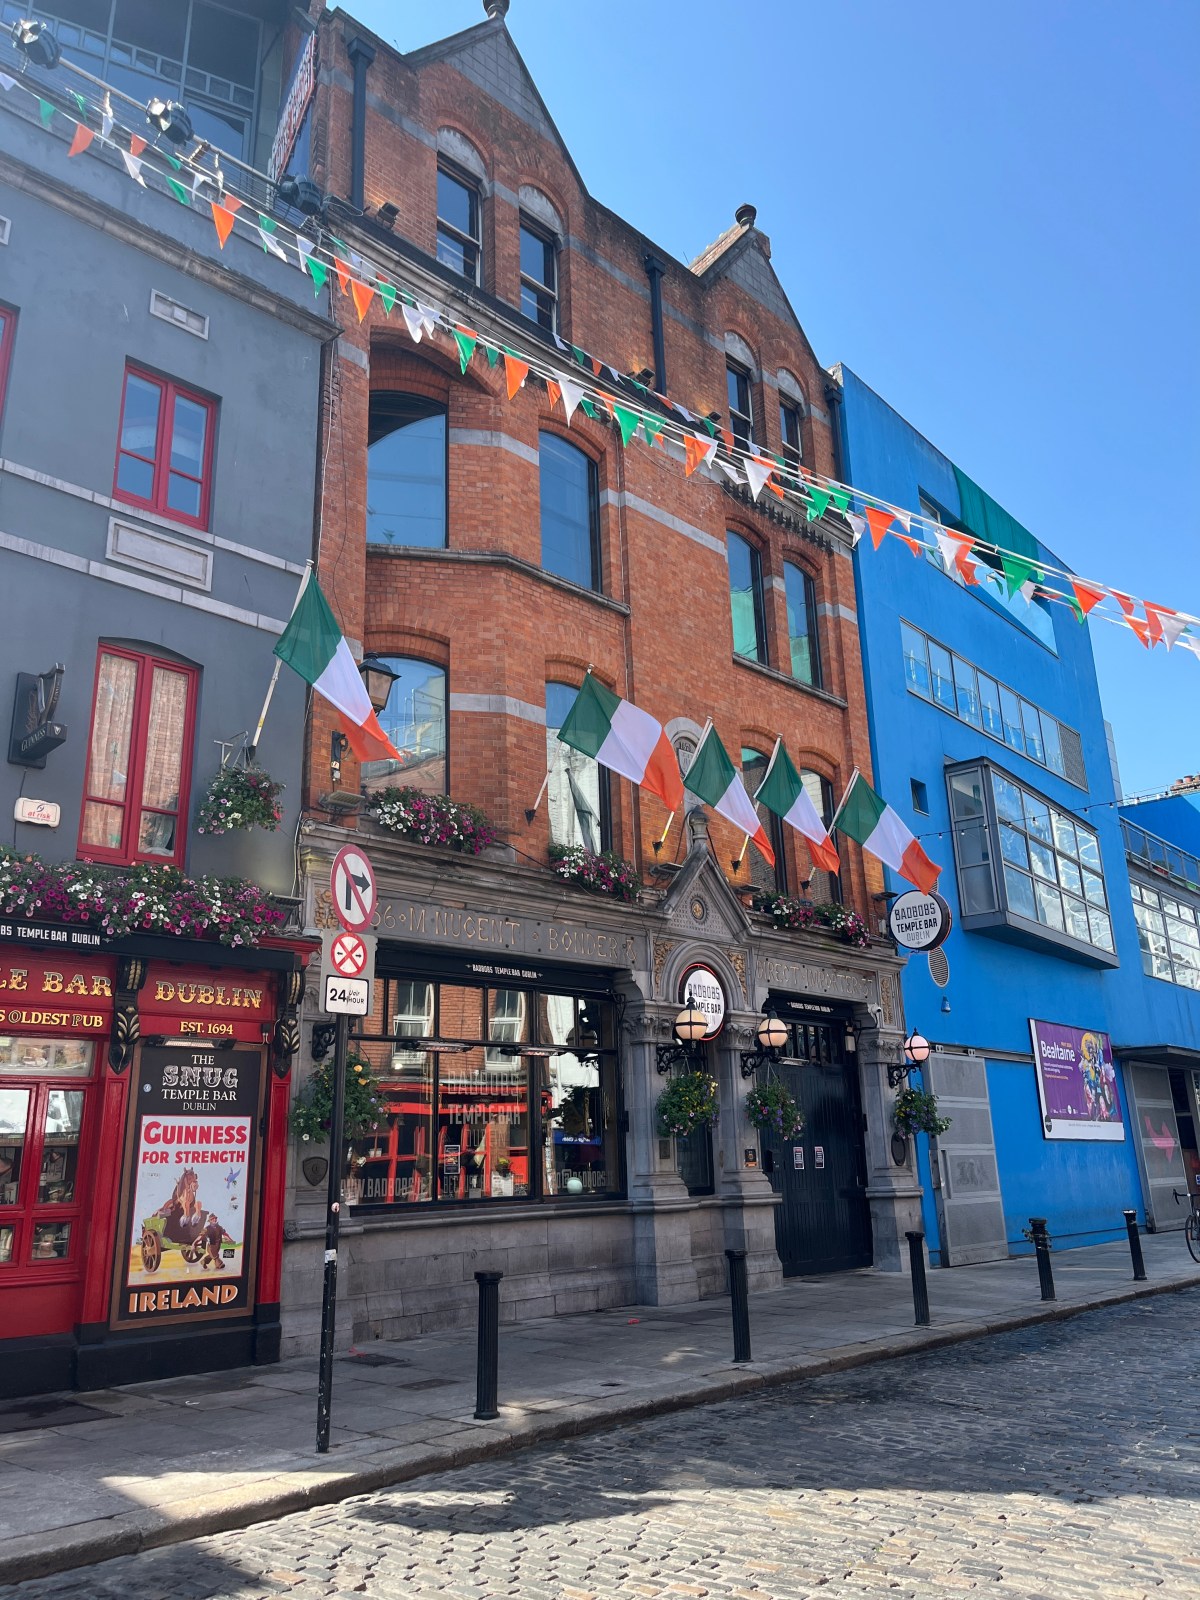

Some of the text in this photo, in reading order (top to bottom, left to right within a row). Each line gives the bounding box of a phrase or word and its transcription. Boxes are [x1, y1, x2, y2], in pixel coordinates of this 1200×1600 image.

[21, 728, 46, 752] GUINNESS
[36, 812, 51, 820] risk
[894, 902, 936, 921] BADBOBS
[896, 918, 938, 933] TEMPLE BAR
[17, 926, 50, 940] TEMPLE
[51, 930, 67, 942] BAR
[72, 933, 100, 945] DUBLIN
[434, 911, 520, 945] NUGENT
[549, 928, 618, 959] BONDER
[906, 930, 931, 942] DUBLIN
[756, 960, 799, 985] DIRECT
[42, 971, 112, 997] BAR
[687, 983, 721, 1000] BADBOBS
[154, 980, 263, 1009] DUBLIN
[329, 988, 347, 1003] 24
[347, 997, 365, 1005] HOUR
[694, 1001, 722, 1014] MPLE BAR
[8, 1010, 70, 1026] OLDEST
[71, 1013, 104, 1028] PUB
[180, 1021, 234, 1035] EST. 1694
[191, 1054, 215, 1065] THE
[1040, 1040, 1076, 1062] Bealtaine
[162, 1065, 239, 1089] SNUG
[161, 1088, 238, 1101] TEMPLE BAR
[182, 1102, 217, 1111] DUBLIN
[448, 1104, 520, 1125] TEMPLE BAR
[143, 1121, 247, 1145] GUINNESS
[142, 1151, 246, 1164] FOR STRENGTH
[128, 1284, 239, 1313] IRELAND
